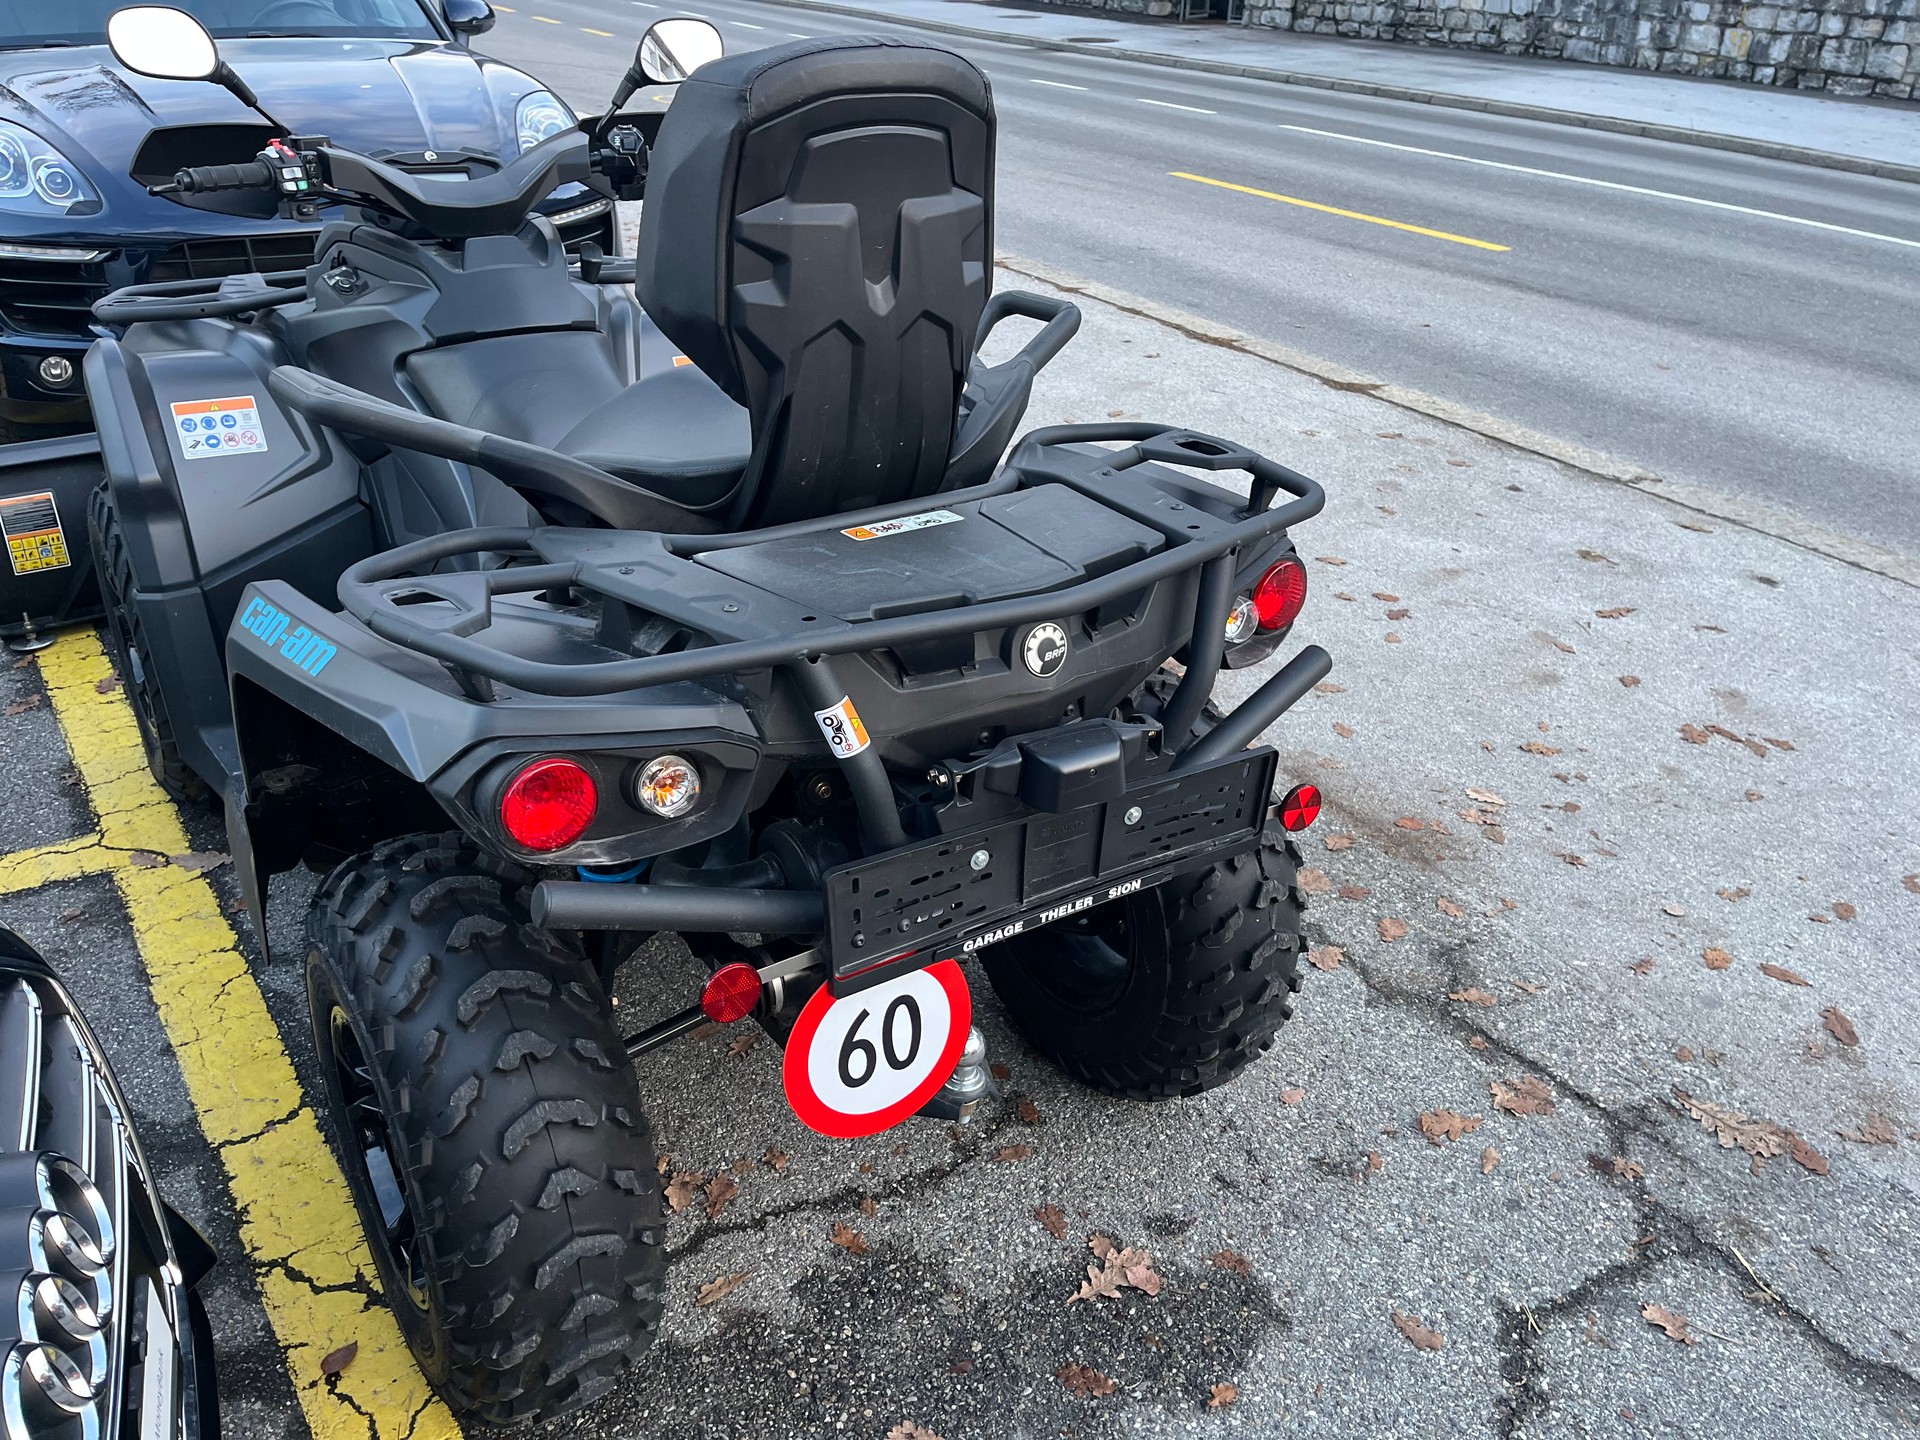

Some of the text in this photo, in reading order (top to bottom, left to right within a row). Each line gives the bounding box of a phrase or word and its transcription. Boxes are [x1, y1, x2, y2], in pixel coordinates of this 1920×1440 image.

[240, 596, 337, 677] can-am
[1044, 646, 1065, 662] BRP
[963, 879, 1142, 952] GARAGE THELER SION
[838, 994, 922, 1089] 60
